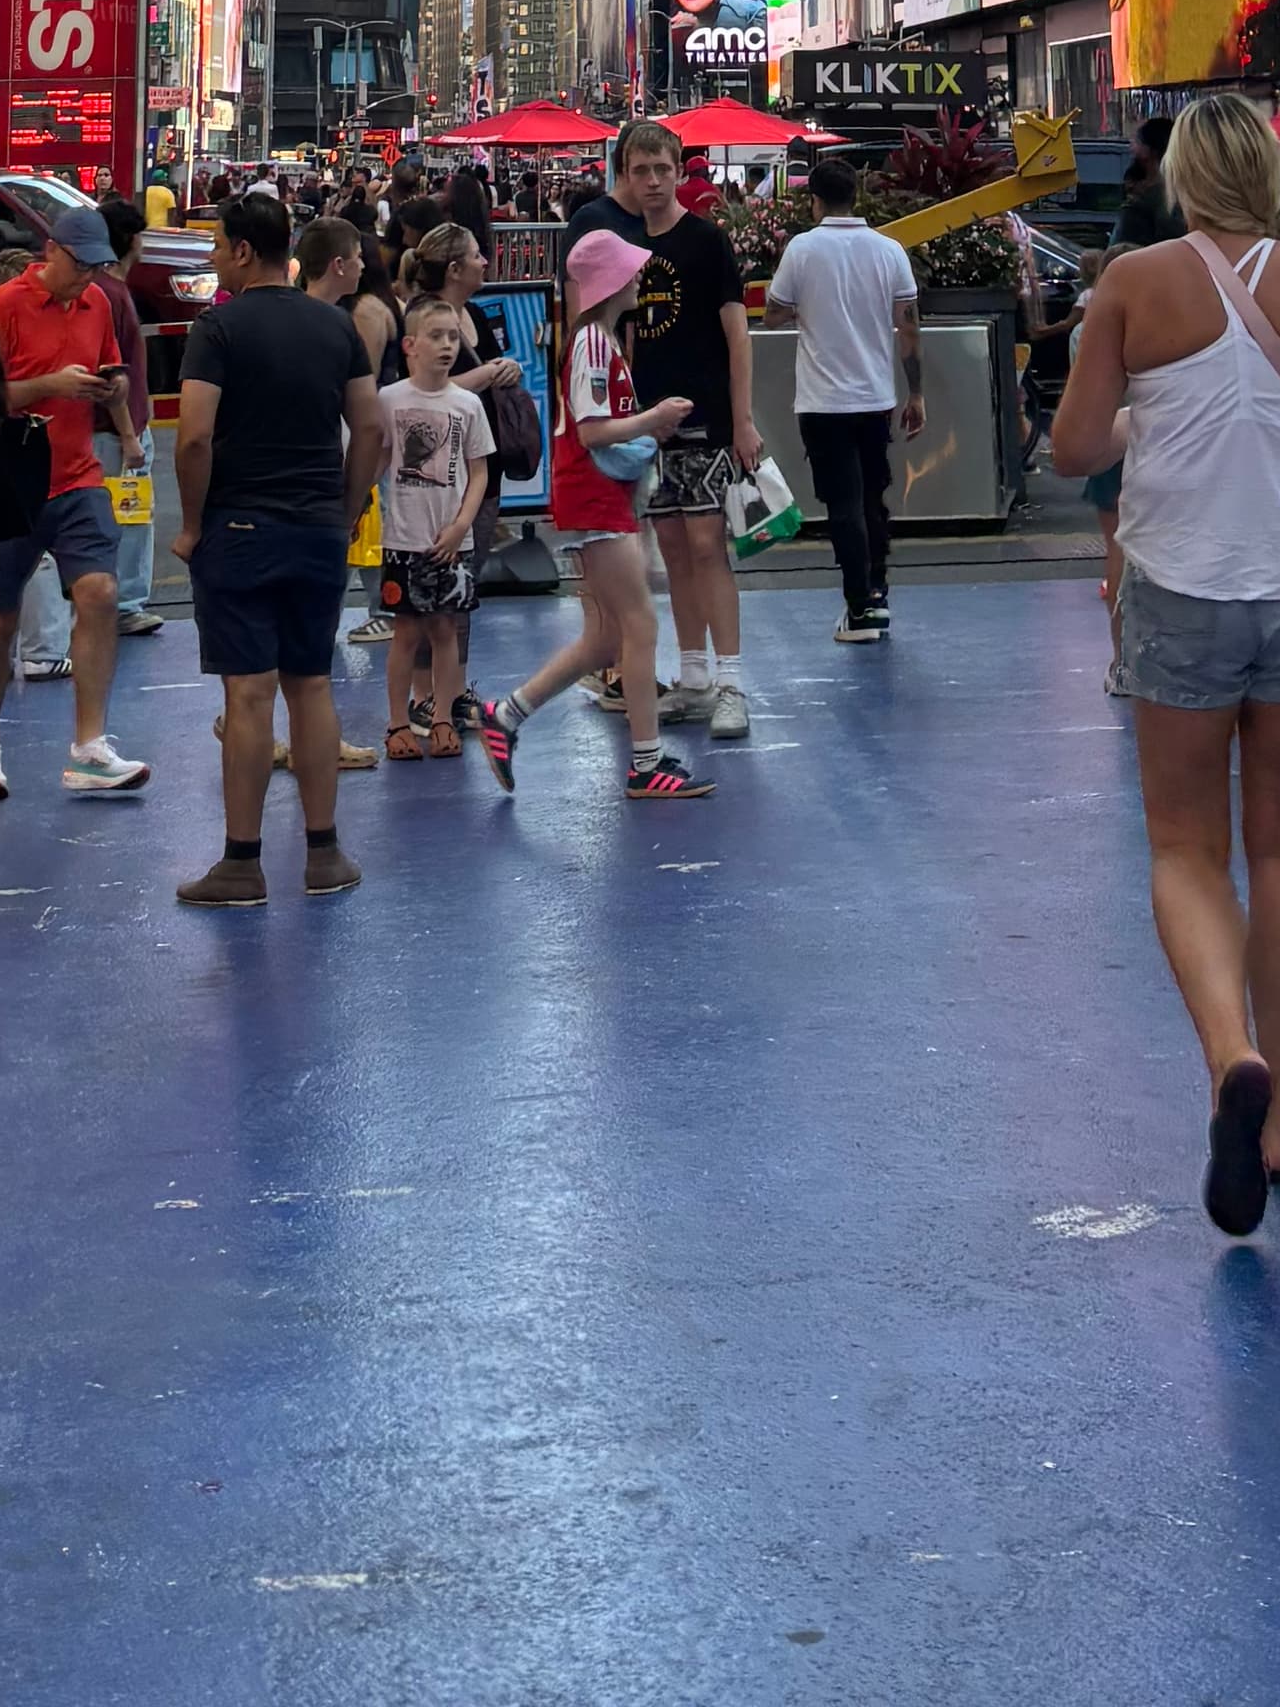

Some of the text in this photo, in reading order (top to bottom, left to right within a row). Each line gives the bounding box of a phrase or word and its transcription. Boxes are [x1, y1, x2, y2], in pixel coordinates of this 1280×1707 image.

[685, 26, 766, 51] amc
[685, 52, 768, 64] THEATRES
[816, 62, 963, 95] KLIKTIX
